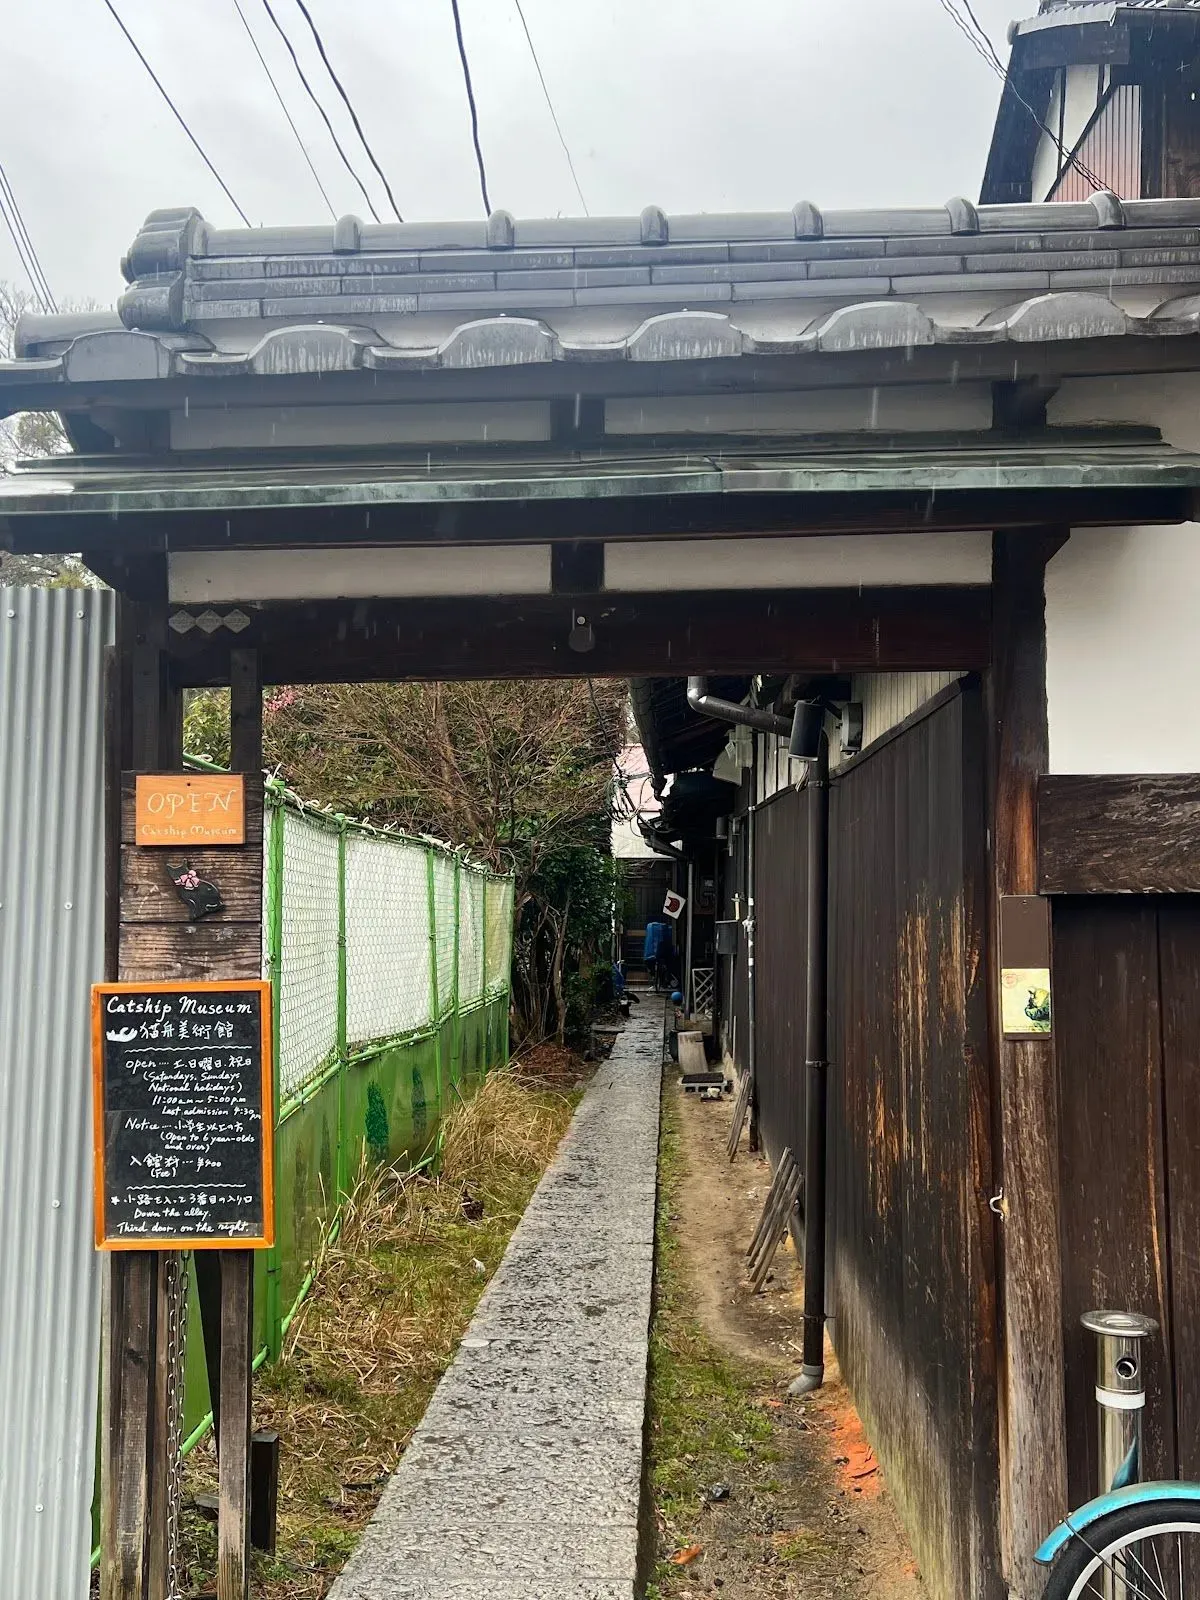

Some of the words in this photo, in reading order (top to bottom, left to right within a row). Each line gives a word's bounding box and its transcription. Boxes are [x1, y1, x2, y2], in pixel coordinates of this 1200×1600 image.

[147, 789, 237, 819] OPEN
[190, 825, 237, 836] Museum
[106, 996, 172, 1022] Catship
[179, 996, 252, 1015] Museum
[139, 1020, 234, 1040] 猫舟美術館
[200, 1071, 240, 1084] Sundays
[148, 1082, 190, 1092] National
[193, 1082, 243, 1095] holidays)
[162, 1106, 181, 1116] Last
[184, 1107, 229, 1116] admission
[125, 1118, 160, 1131] Notice
[160, 1131, 187, 1144] (Open
[189, 1132, 200, 1142] to
[202, 1132, 209, 1142] 6
[210, 1134, 255, 1145] year-olds
[164, 1143, 184, 1151] and
[185, 1143, 211, 1153] over)
[150, 1167, 177, 1178] (Fee)
[133, 1208, 161, 1219] Down
[162, 1208, 181, 1217] the
[117, 1222, 148, 1234] Third
[151, 1222, 177, 1234] door,
[195, 1222, 214, 1233] the
